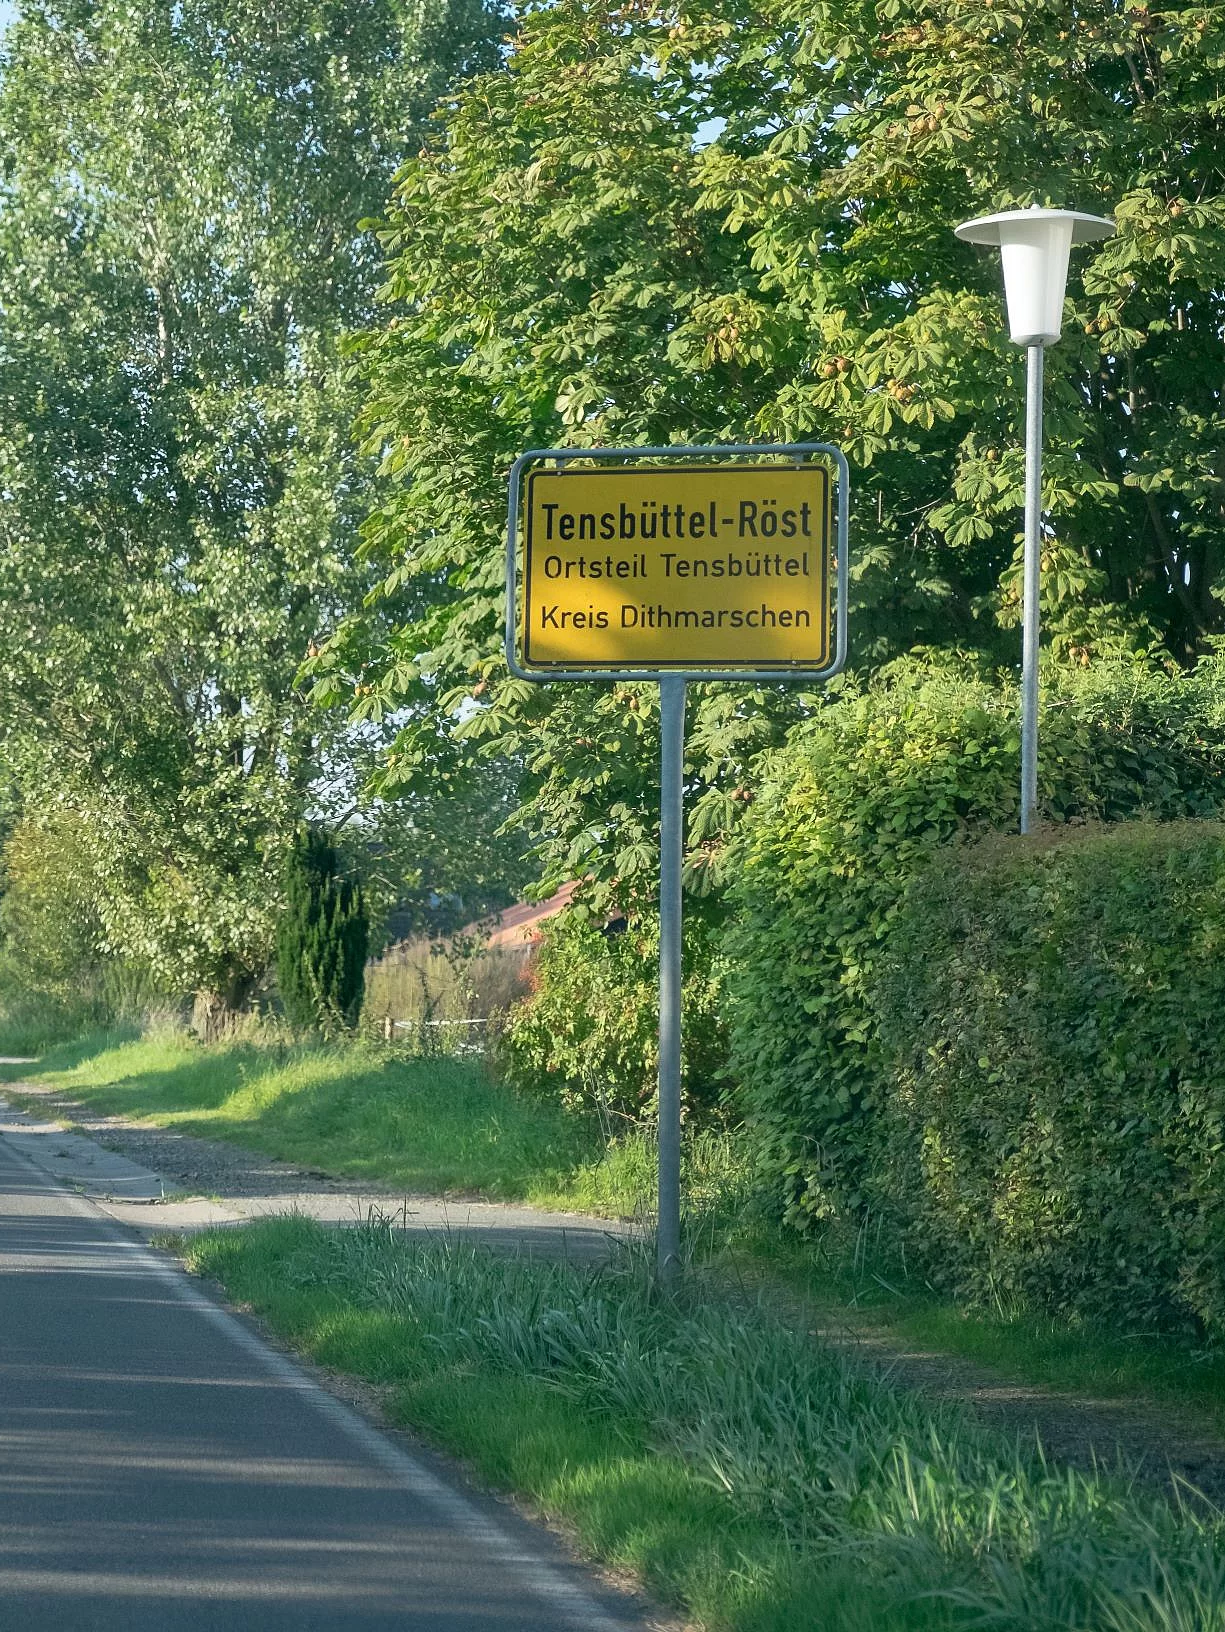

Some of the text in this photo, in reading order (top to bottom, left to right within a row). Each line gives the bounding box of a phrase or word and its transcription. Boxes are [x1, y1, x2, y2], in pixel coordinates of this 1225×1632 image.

[541, 500, 812, 540] Tensbüttel-Röst
[544, 552, 810, 578] Ortsteil Tensbüttel
[541, 603, 811, 629] Kreis Dithmarschen
